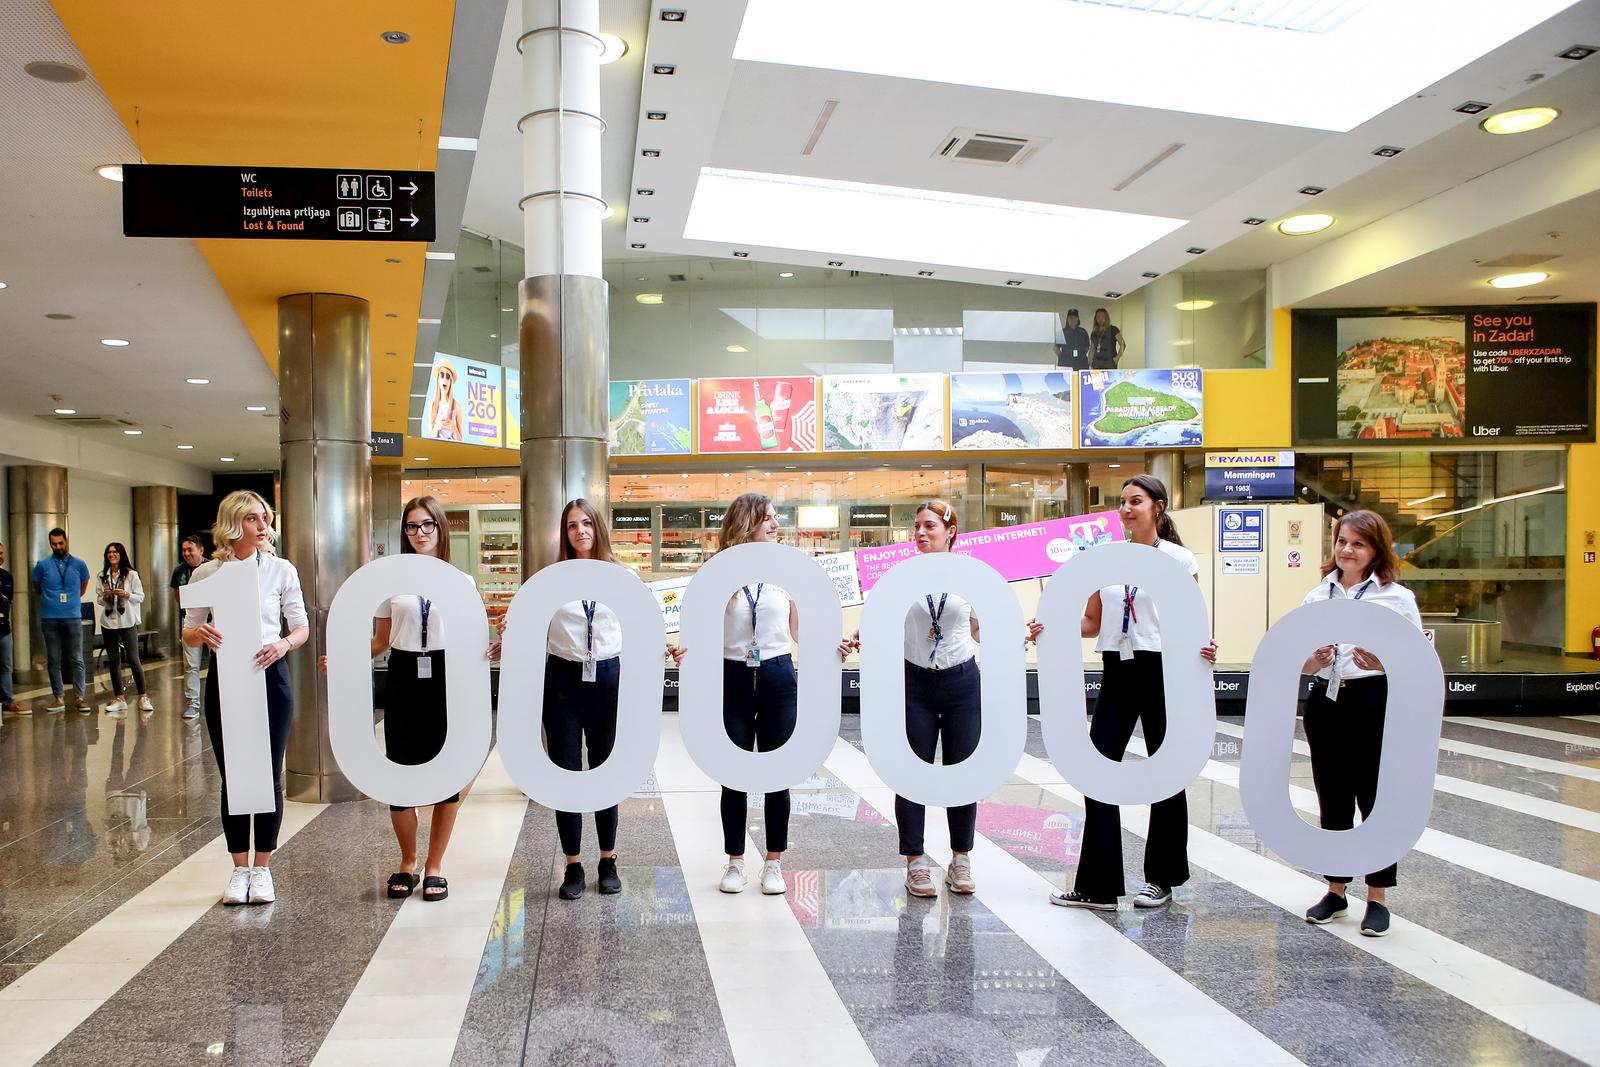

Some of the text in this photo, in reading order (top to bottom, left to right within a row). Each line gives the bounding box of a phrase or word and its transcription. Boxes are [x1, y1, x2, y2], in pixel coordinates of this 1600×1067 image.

[240, 173, 257, 184] WC
[241, 187, 273, 198] Toilets
[243, 206, 331, 219] Izgubljena prtljaga
[243, 220, 304, 231] Lost & Found
[1473, 314, 1532, 329] See you
[1473, 329, 1534, 342] in Zadar!
[1488, 349, 1508, 357] code
[1508, 348, 1562, 356] UBERXZADAR
[1482, 358, 1496, 367] get
[1514, 356, 1525, 364] off
[1525, 357, 1542, 366] your
[1543, 355, 1559, 364] first
[1560, 355, 1572, 365] trip
[1473, 364, 1509, 372] with Uber.
[1171, 372, 1199, 382] DUGI
[467, 381, 497, 403] NET
[713, 390, 741, 399] DRINK
[467, 401, 497, 420] 2GO
[1472, 425, 1500, 436] Uber
[1218, 455, 1276, 463] RYANAIR
[1224, 471, 1276, 480] Memmingen
[1001, 512, 1017, 521] Dior
[993, 526, 1047, 542] INTERNET!
[863, 550, 896, 563] ENJOY
[664, 679, 679, 688] Cro
[1213, 680, 1239, 691] Uber
[1448, 681, 1477, 692] Uber
[1566, 682, 1593, 693] Explore
